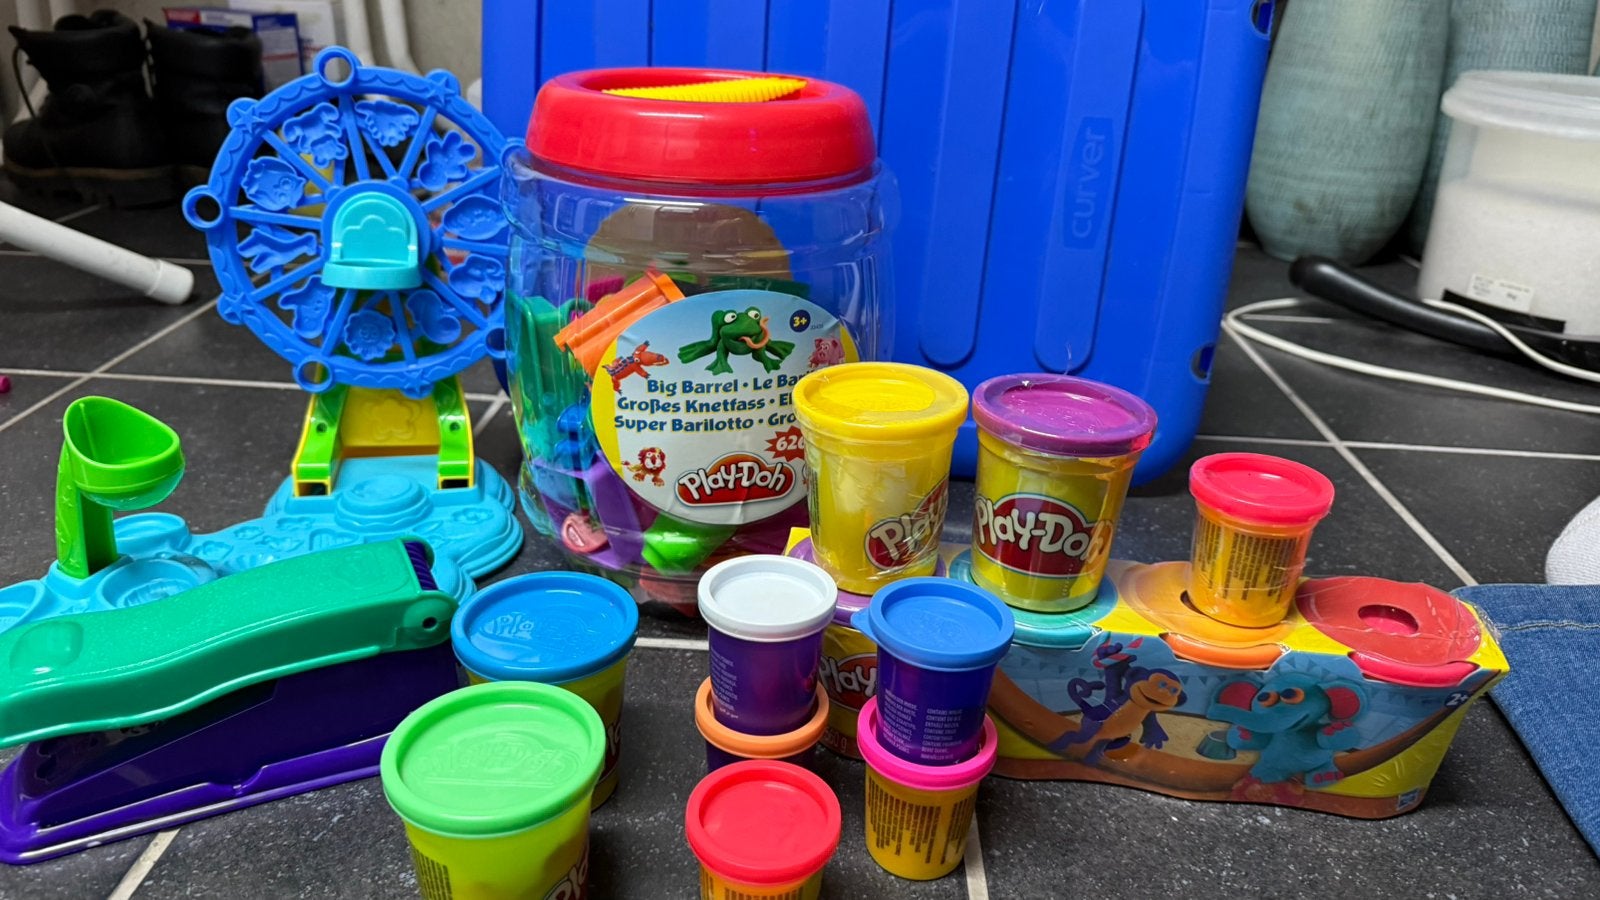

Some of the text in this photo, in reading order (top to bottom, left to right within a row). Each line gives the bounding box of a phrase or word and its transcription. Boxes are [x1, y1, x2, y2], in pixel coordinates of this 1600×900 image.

[1072, 126, 1106, 239] curver
[793, 316, 808, 328] 3+
[646, 379, 677, 396] Big
[681, 378, 739, 395] Barrel
[753, 377, 773, 391] Le
[617, 396, 681, 414] Großes
[685, 395, 766, 413] Knetfass
[614, 415, 667, 433] Super
[671, 414, 754, 432] Barilotto
[679, 460, 787, 500] Play-Doh
[1446, 692, 1470, 706] 2+
